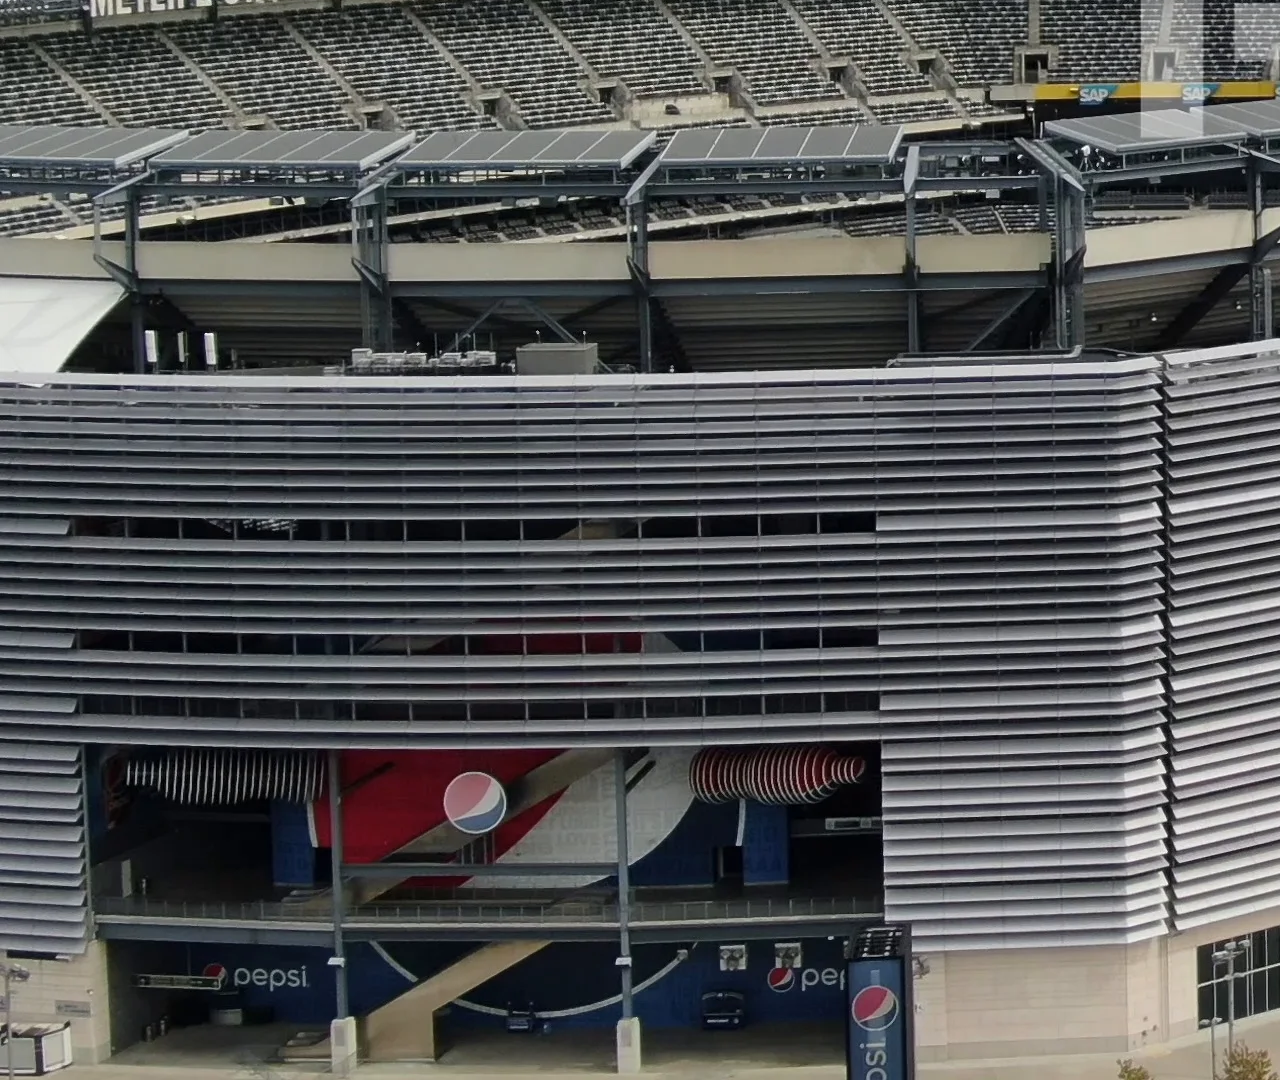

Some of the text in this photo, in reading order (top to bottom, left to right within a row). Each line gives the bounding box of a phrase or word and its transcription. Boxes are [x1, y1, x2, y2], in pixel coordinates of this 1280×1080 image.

[1079, 87, 1109, 103] SAP
[1182, 86, 1211, 101] SAP
[234, 965, 307, 992] pepsi
